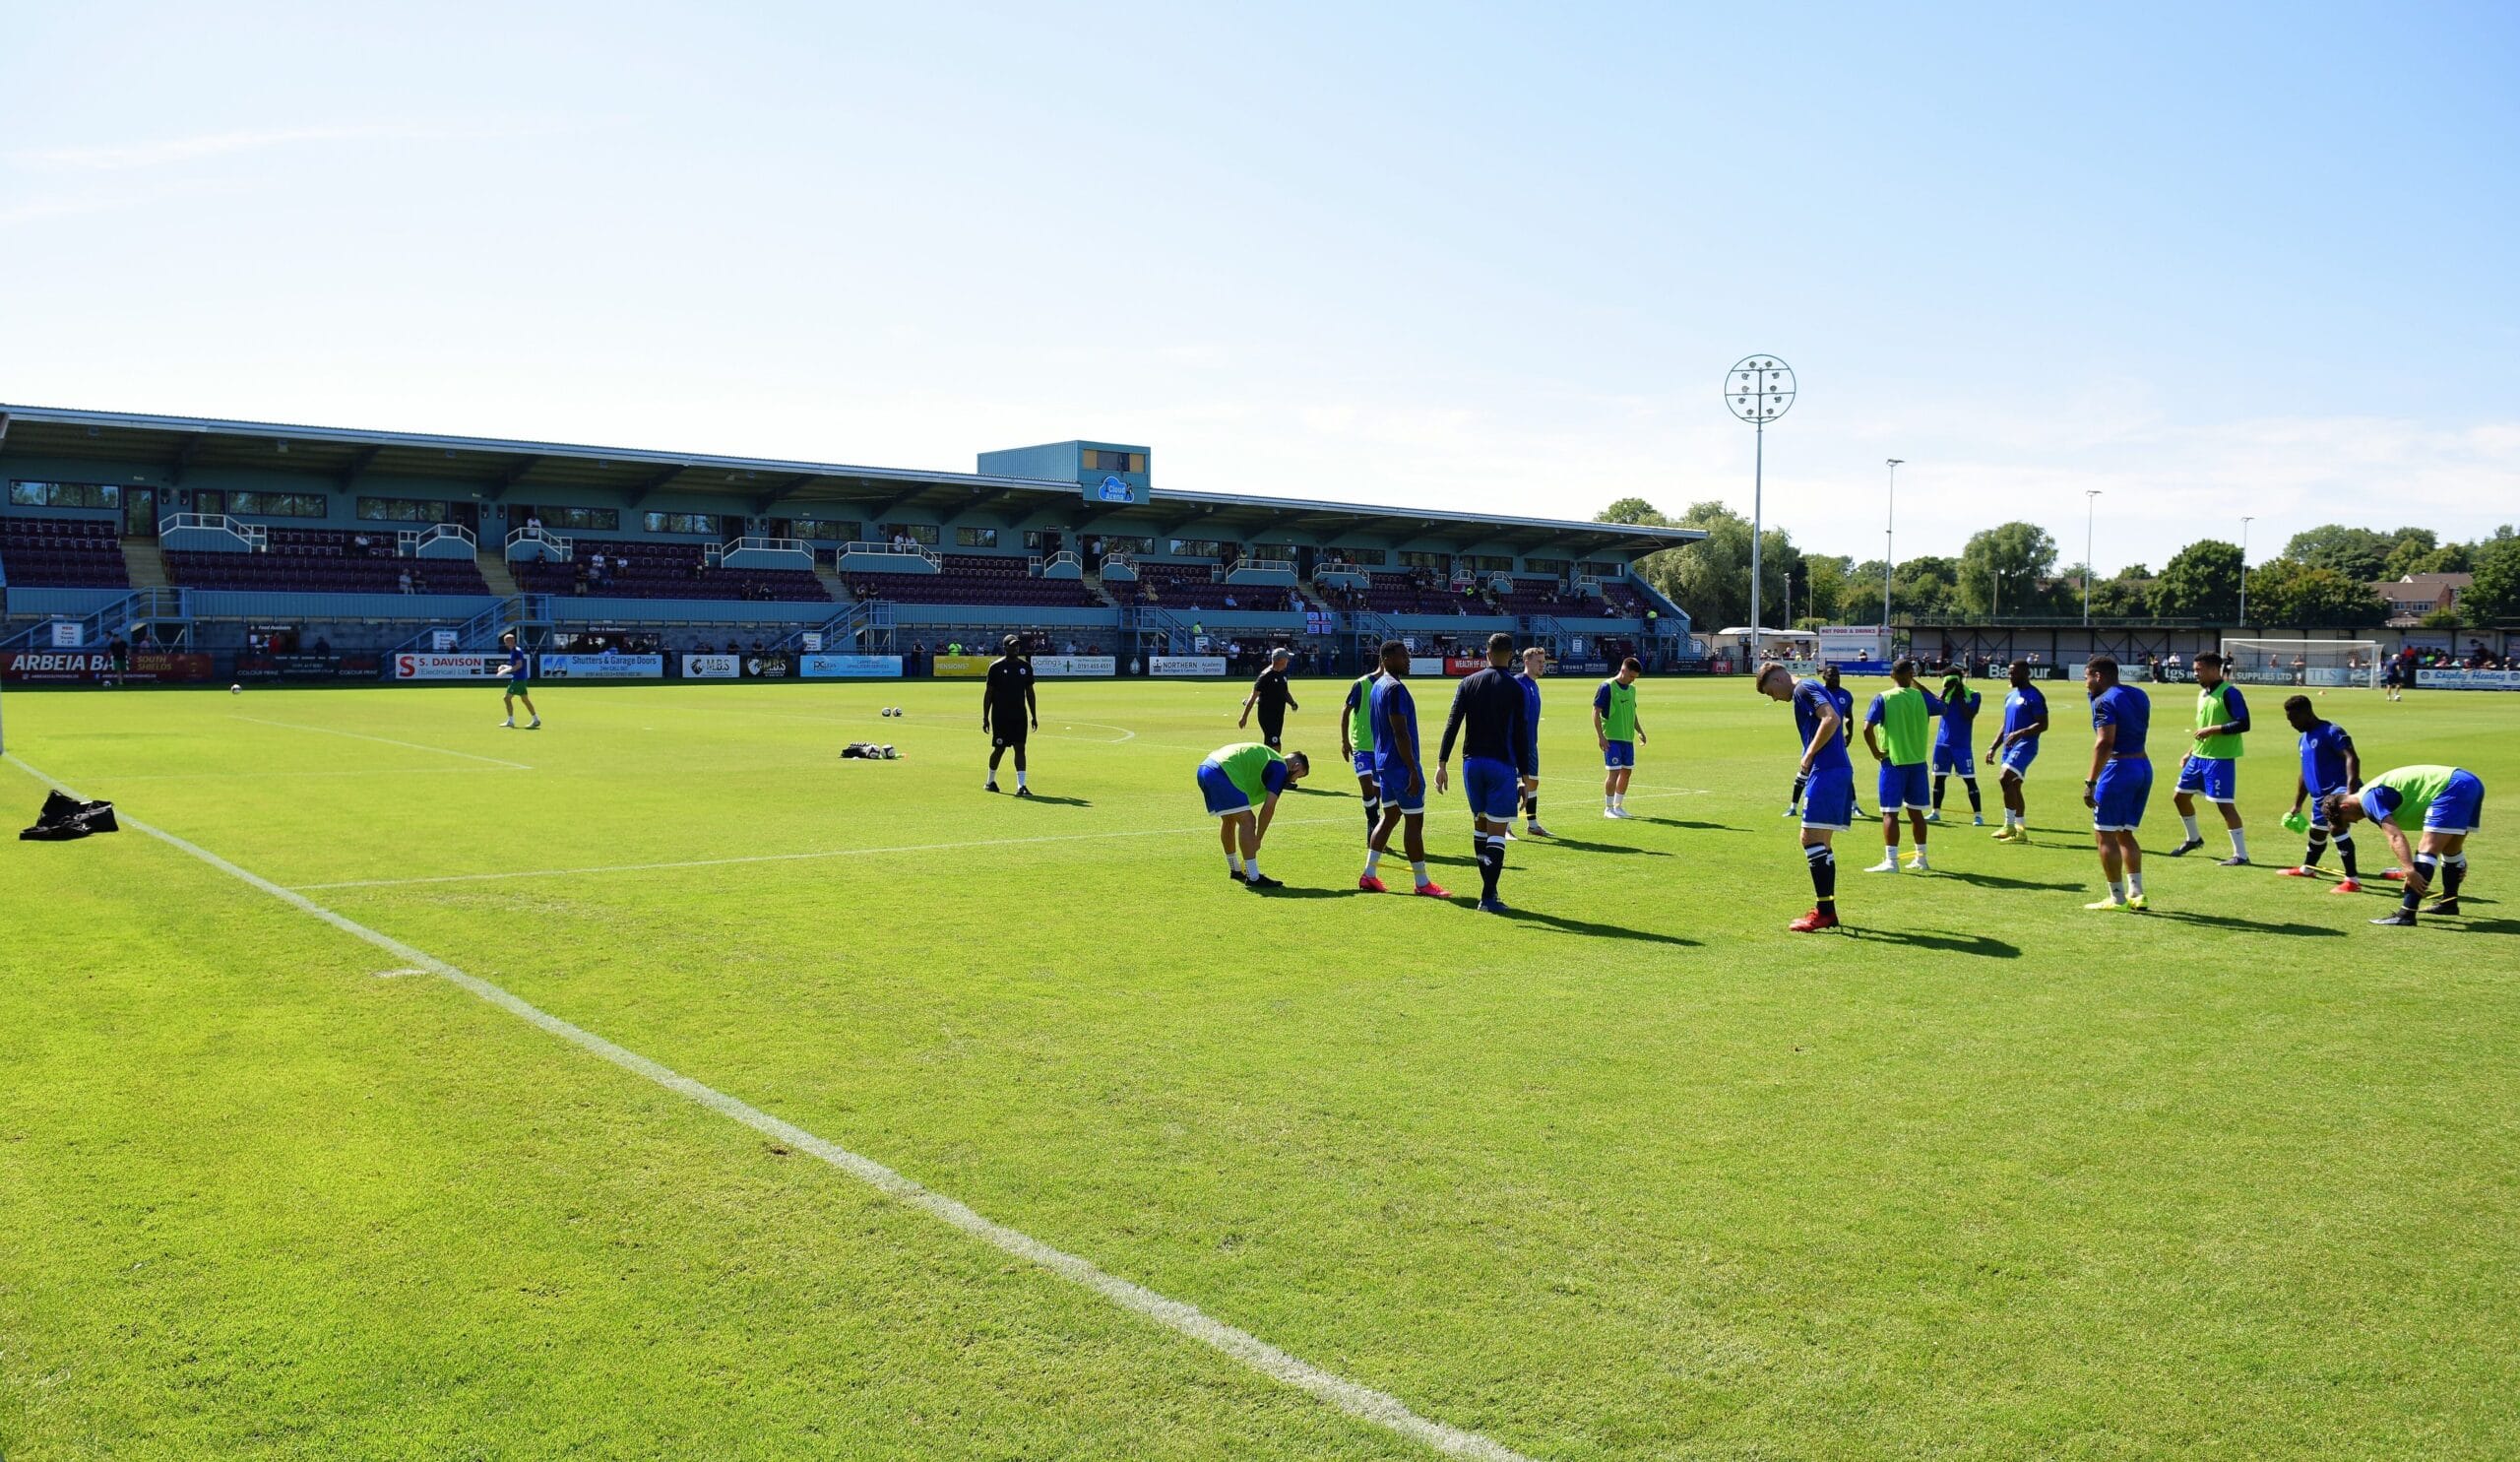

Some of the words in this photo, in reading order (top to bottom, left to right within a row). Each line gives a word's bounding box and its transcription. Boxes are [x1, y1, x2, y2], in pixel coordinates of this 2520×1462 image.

[11, 655, 85, 670] ARBEIA
[90, 655, 130, 670] BA
[432, 658, 481, 667] DAVISON
[572, 656, 603, 665] Shutters
[604, 656, 609, 665] &
[610, 656, 636, 667] Garage
[637, 656, 658, 665] Doors
[1455, 660, 1473, 668] WEALTH
[2165, 667, 2185, 682] tgs
[2236, 672, 2276, 681] SUPPLIES
[2277, 672, 2293, 681] LTD
[2312, 669, 2339, 680] TLS
[2215, 779, 2220, 790] 2
